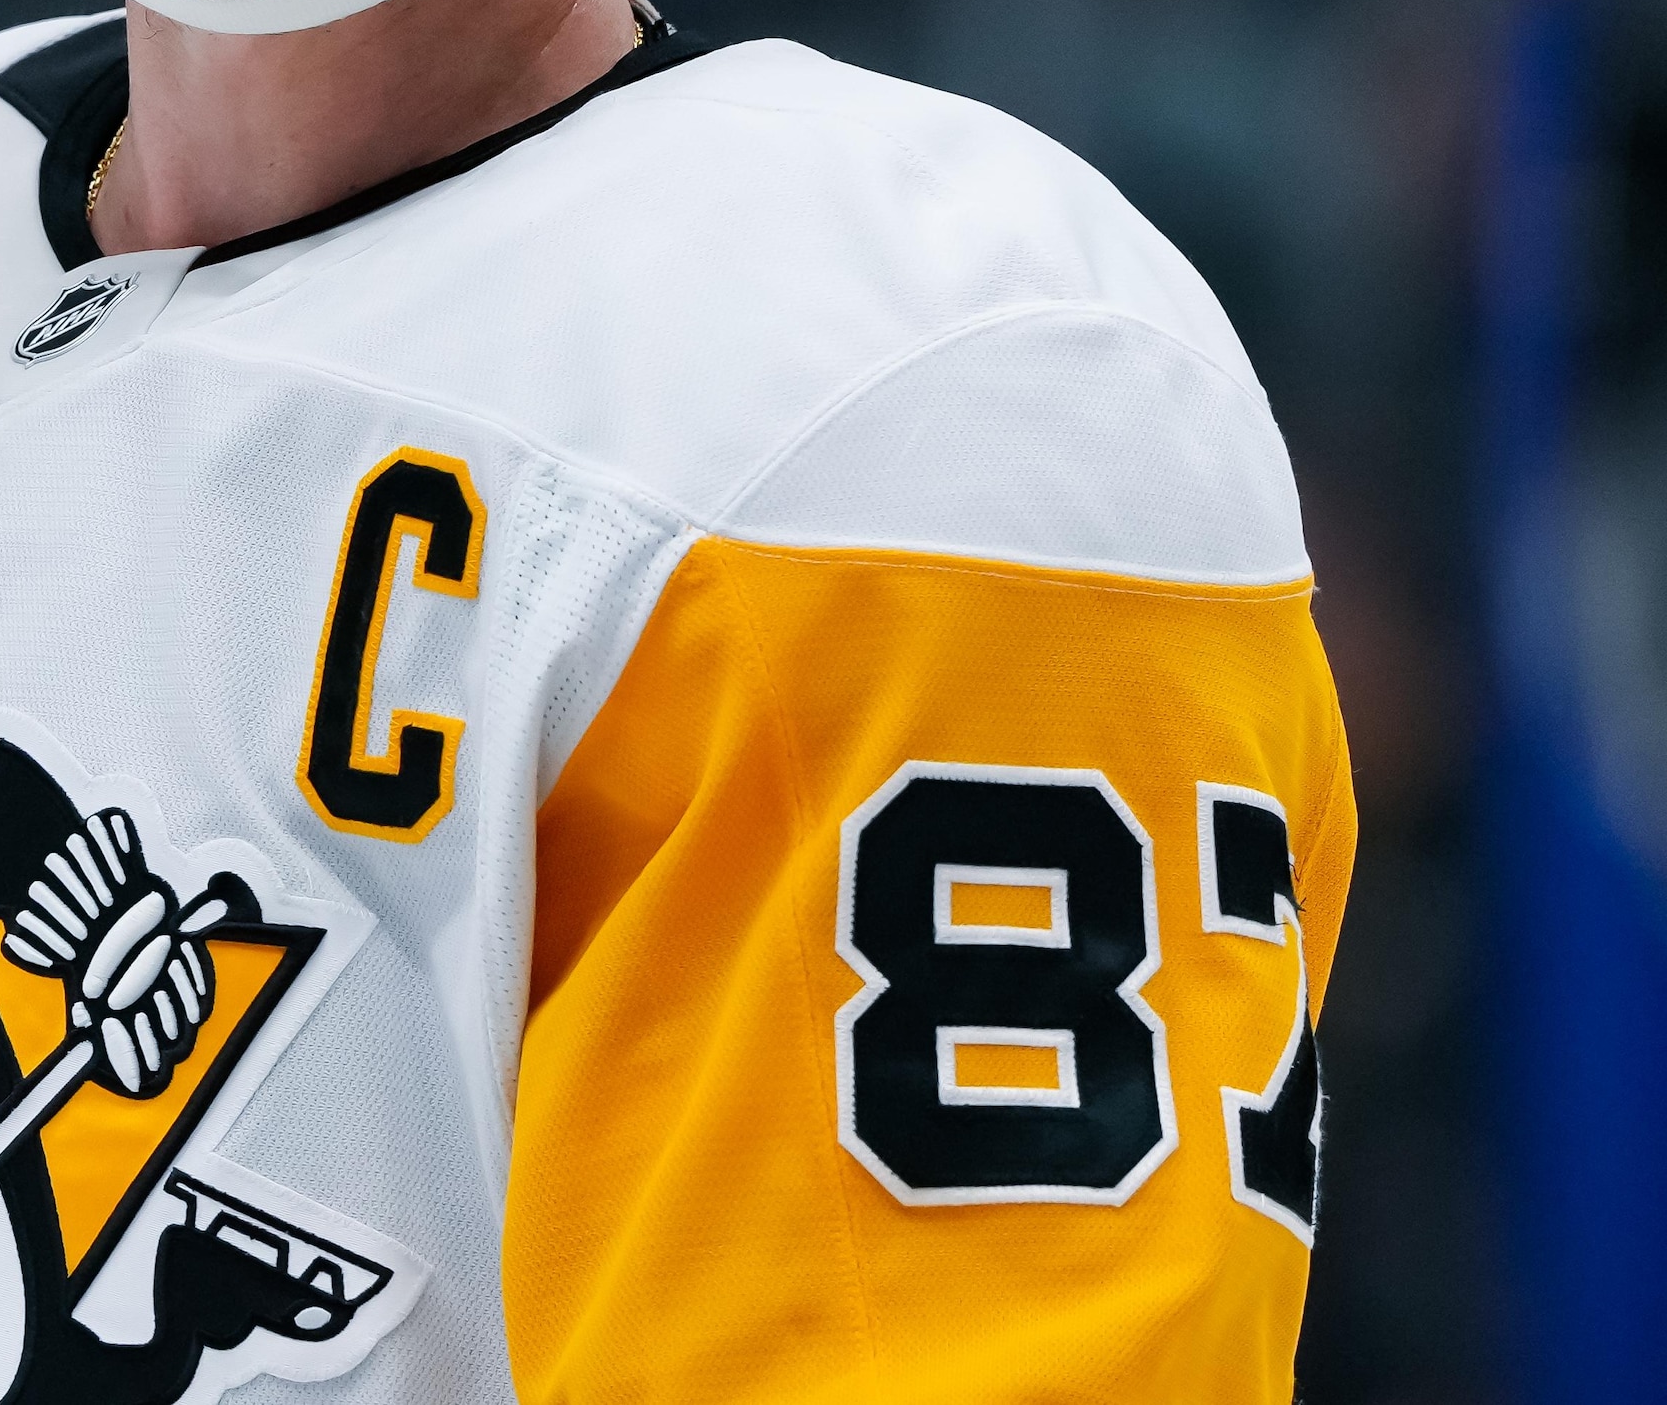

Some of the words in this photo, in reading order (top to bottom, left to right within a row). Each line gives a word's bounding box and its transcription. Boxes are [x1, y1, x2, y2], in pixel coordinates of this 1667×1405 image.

[28, 296, 108, 347] NHL
[295, 445, 488, 844] C
[834, 759, 1327, 1280] 87
